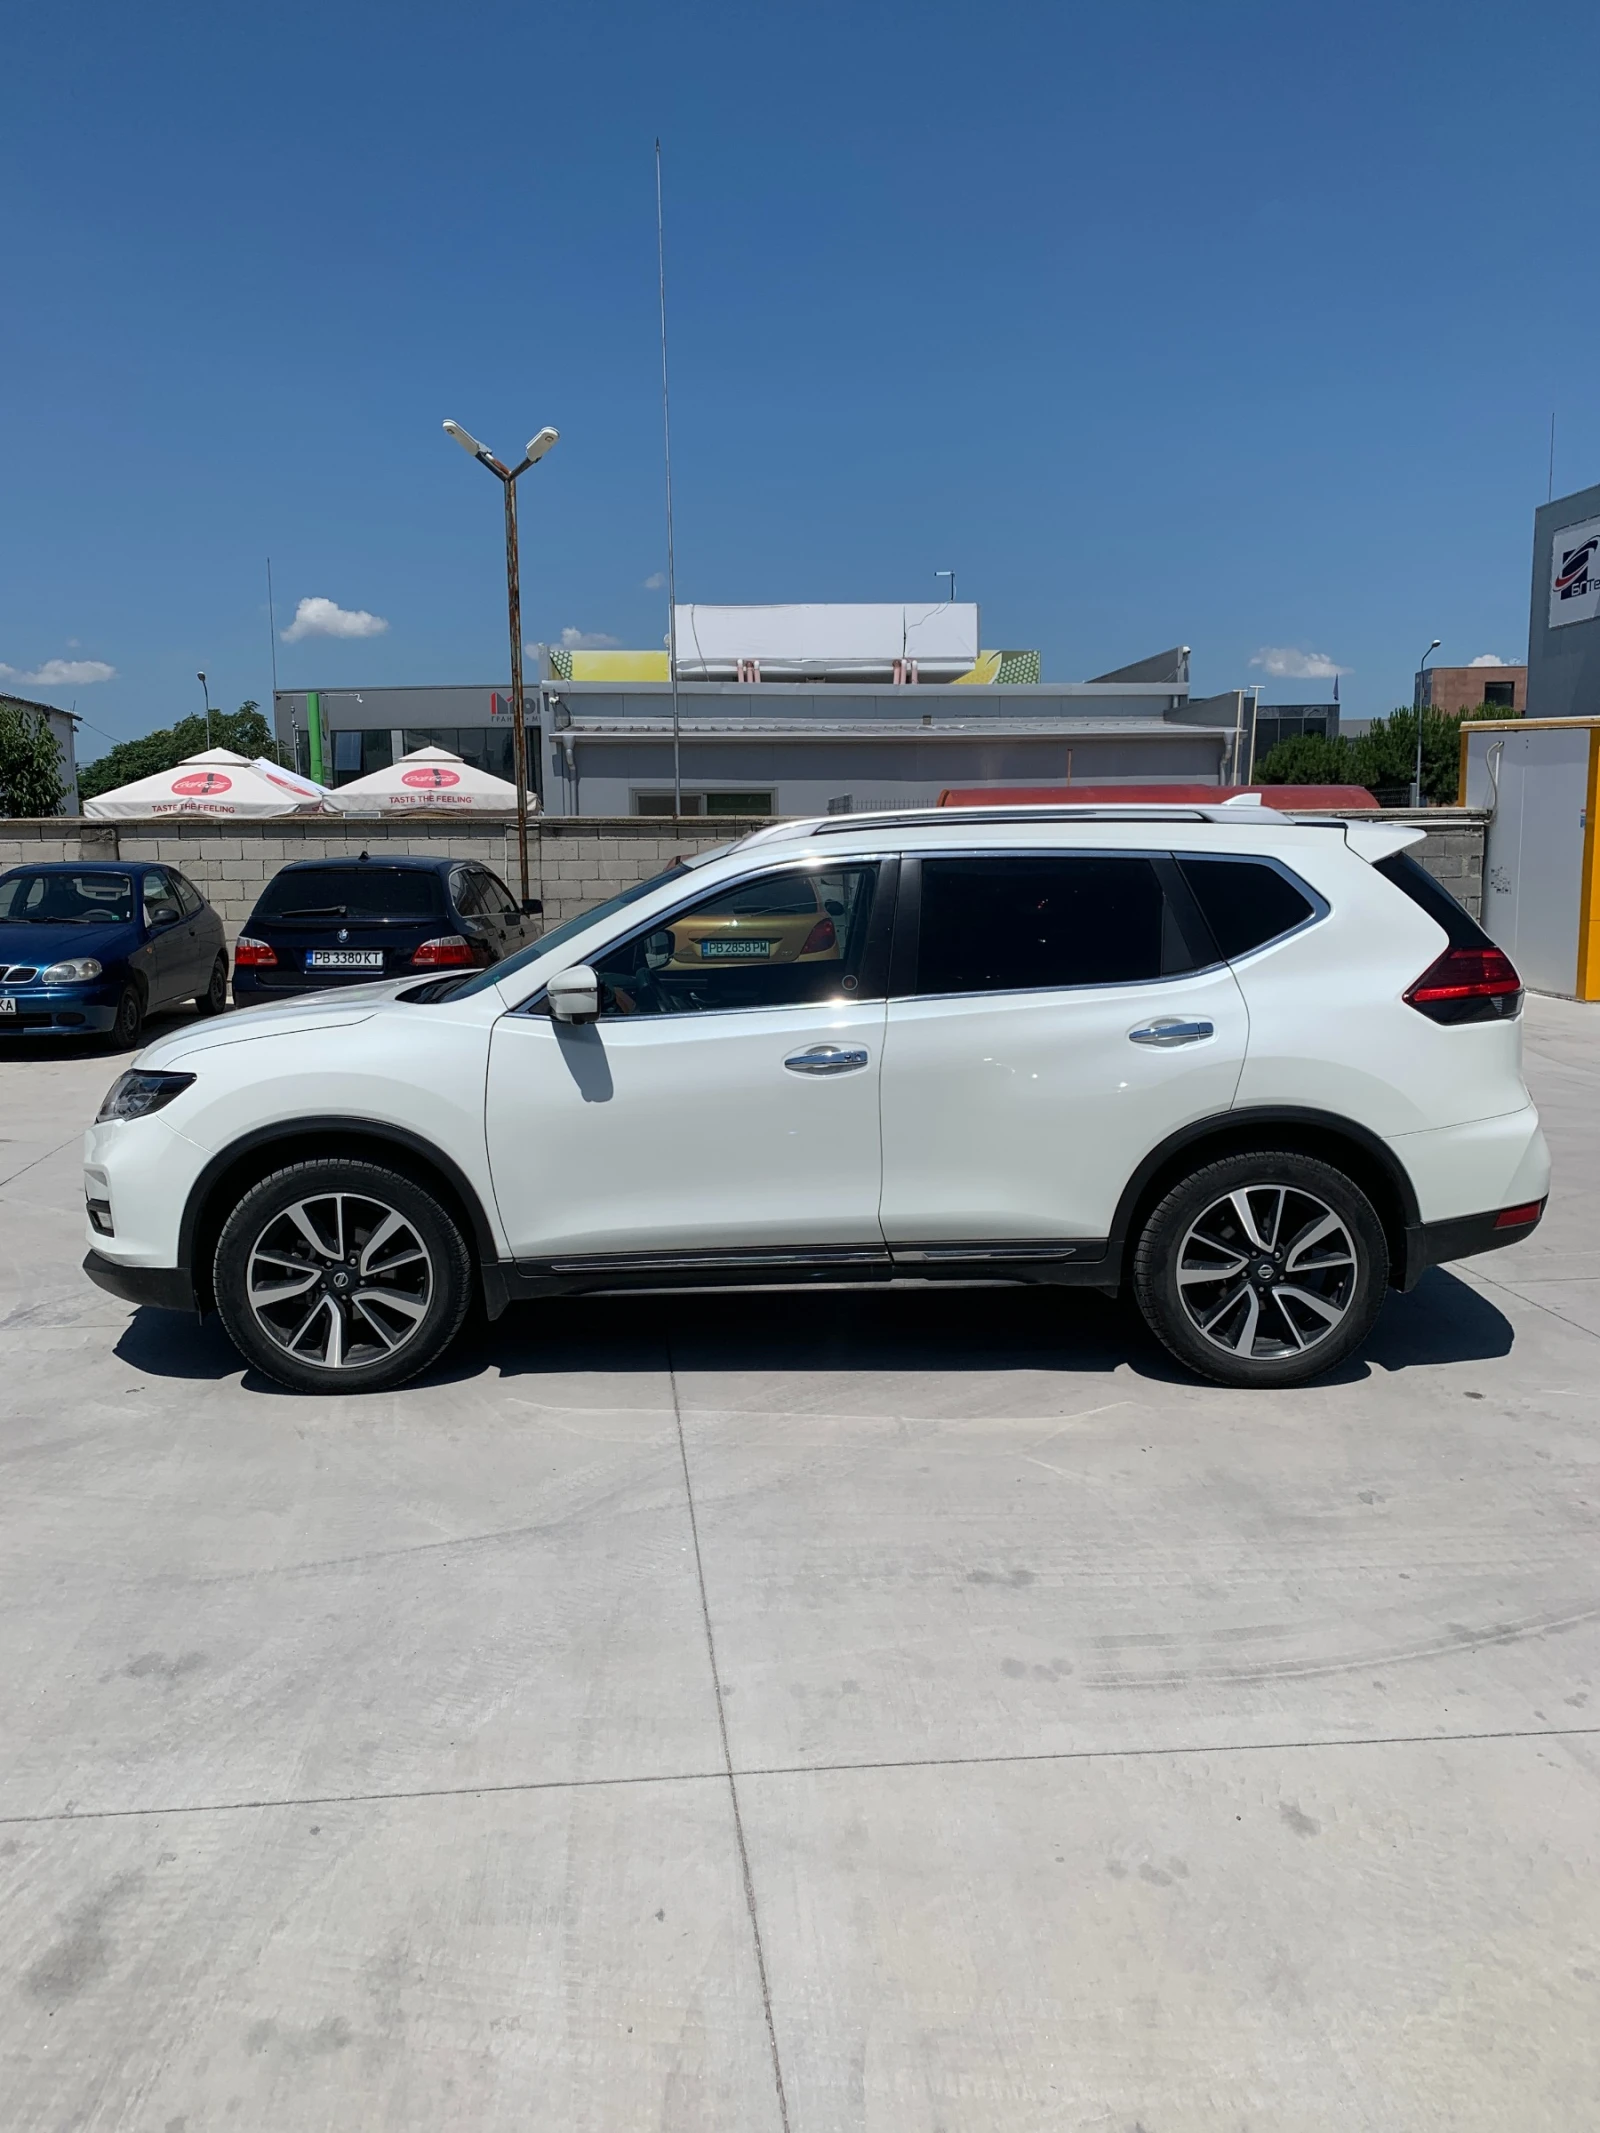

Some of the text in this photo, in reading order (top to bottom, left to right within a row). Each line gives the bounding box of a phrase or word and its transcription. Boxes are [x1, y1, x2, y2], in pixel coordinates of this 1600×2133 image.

[389, 794, 472, 804] TASTE THE FEELING
[151, 802, 236, 814] TASTE THE FEELING
